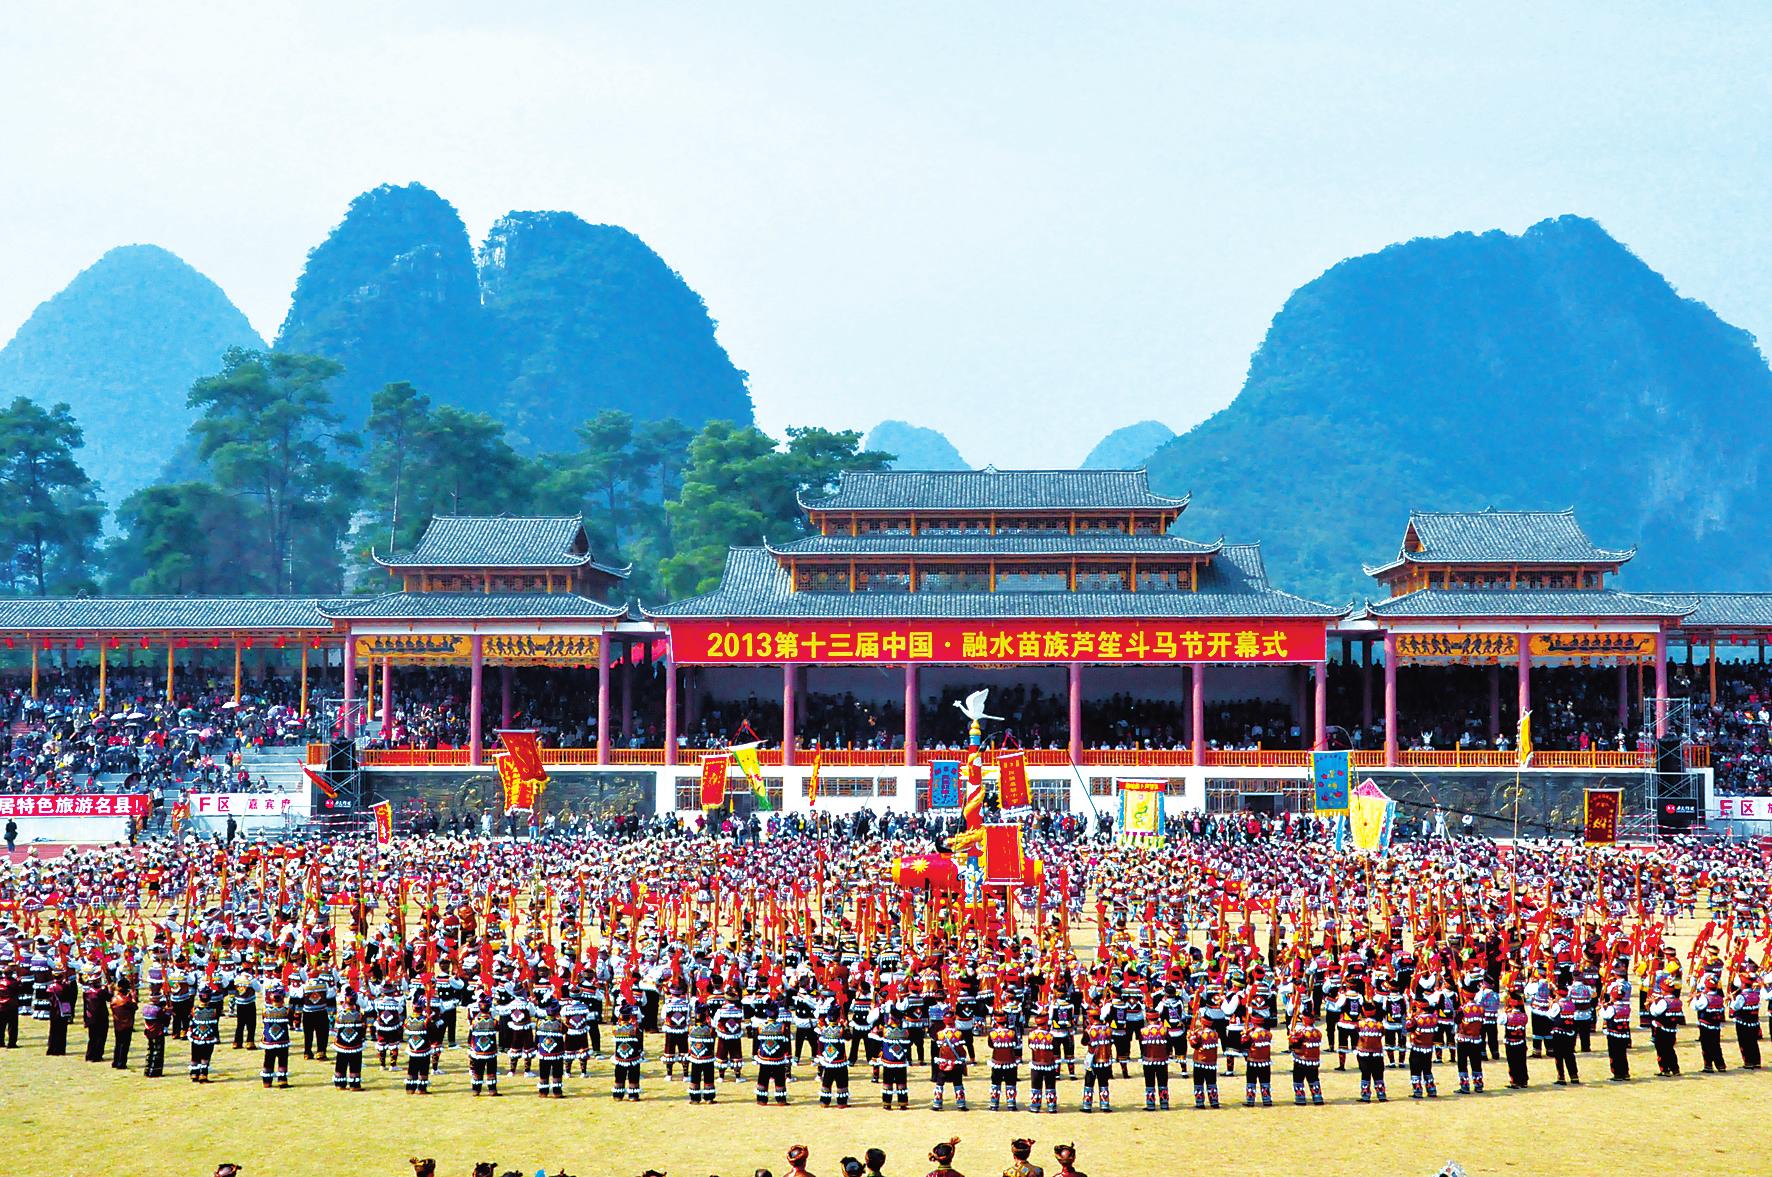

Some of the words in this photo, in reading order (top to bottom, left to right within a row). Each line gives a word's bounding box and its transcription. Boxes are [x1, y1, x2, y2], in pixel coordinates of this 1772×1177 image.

[707, 631, 1288, 659] 2013第十三届中国·融水苗族芦笙斗马节开幕式
[199, 797, 230, 812] F区
